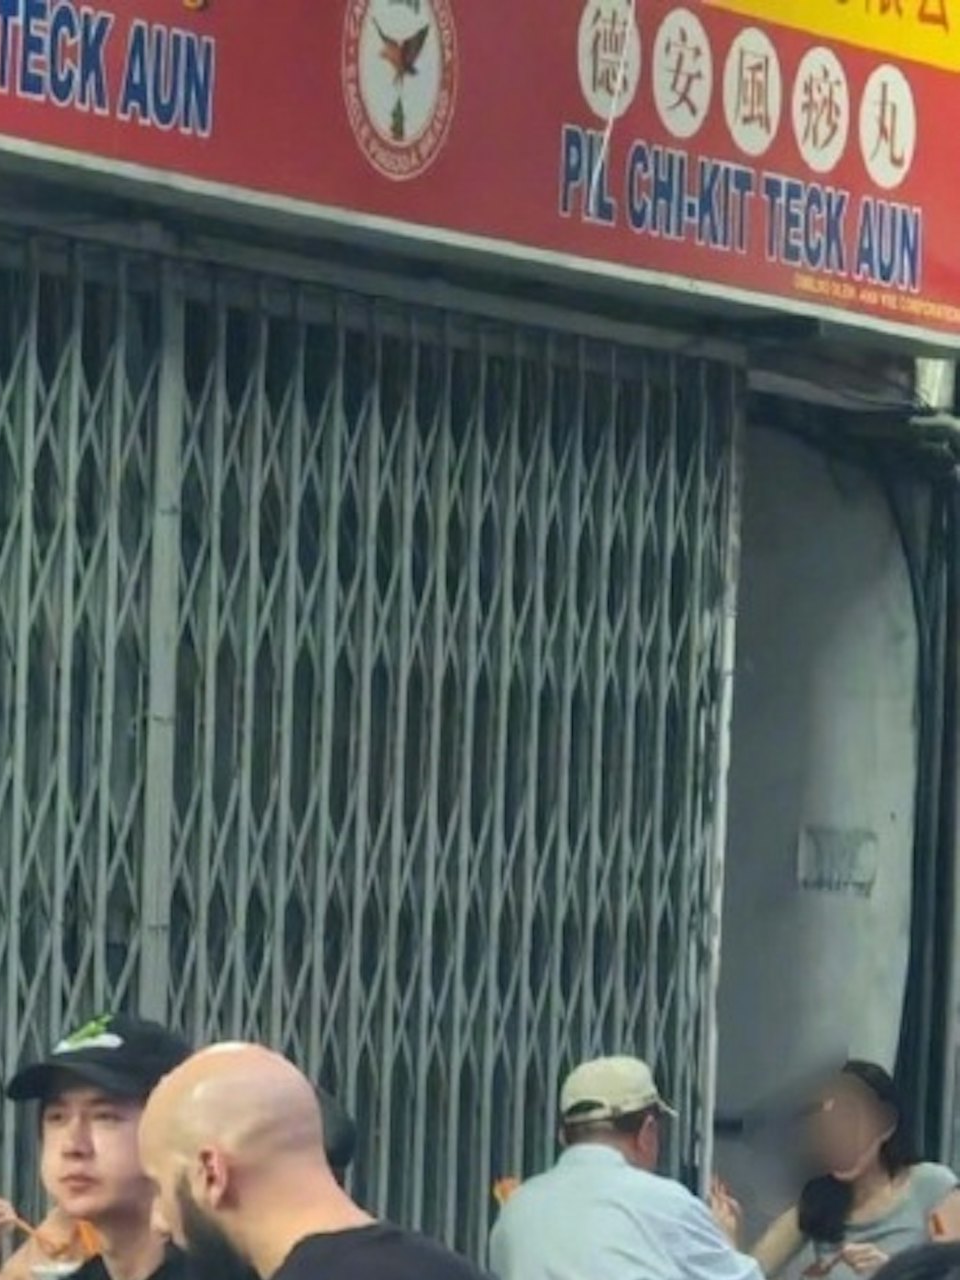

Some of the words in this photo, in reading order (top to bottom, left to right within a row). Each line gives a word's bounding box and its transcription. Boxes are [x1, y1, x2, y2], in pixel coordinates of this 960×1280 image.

[116, 17, 215, 138] AUN
[559, 123, 616, 226] PIL
[626, 138, 756, 255] CHI-KIT
[761, 170, 850, 276] TECK
[852, 196, 922, 293] AUN
